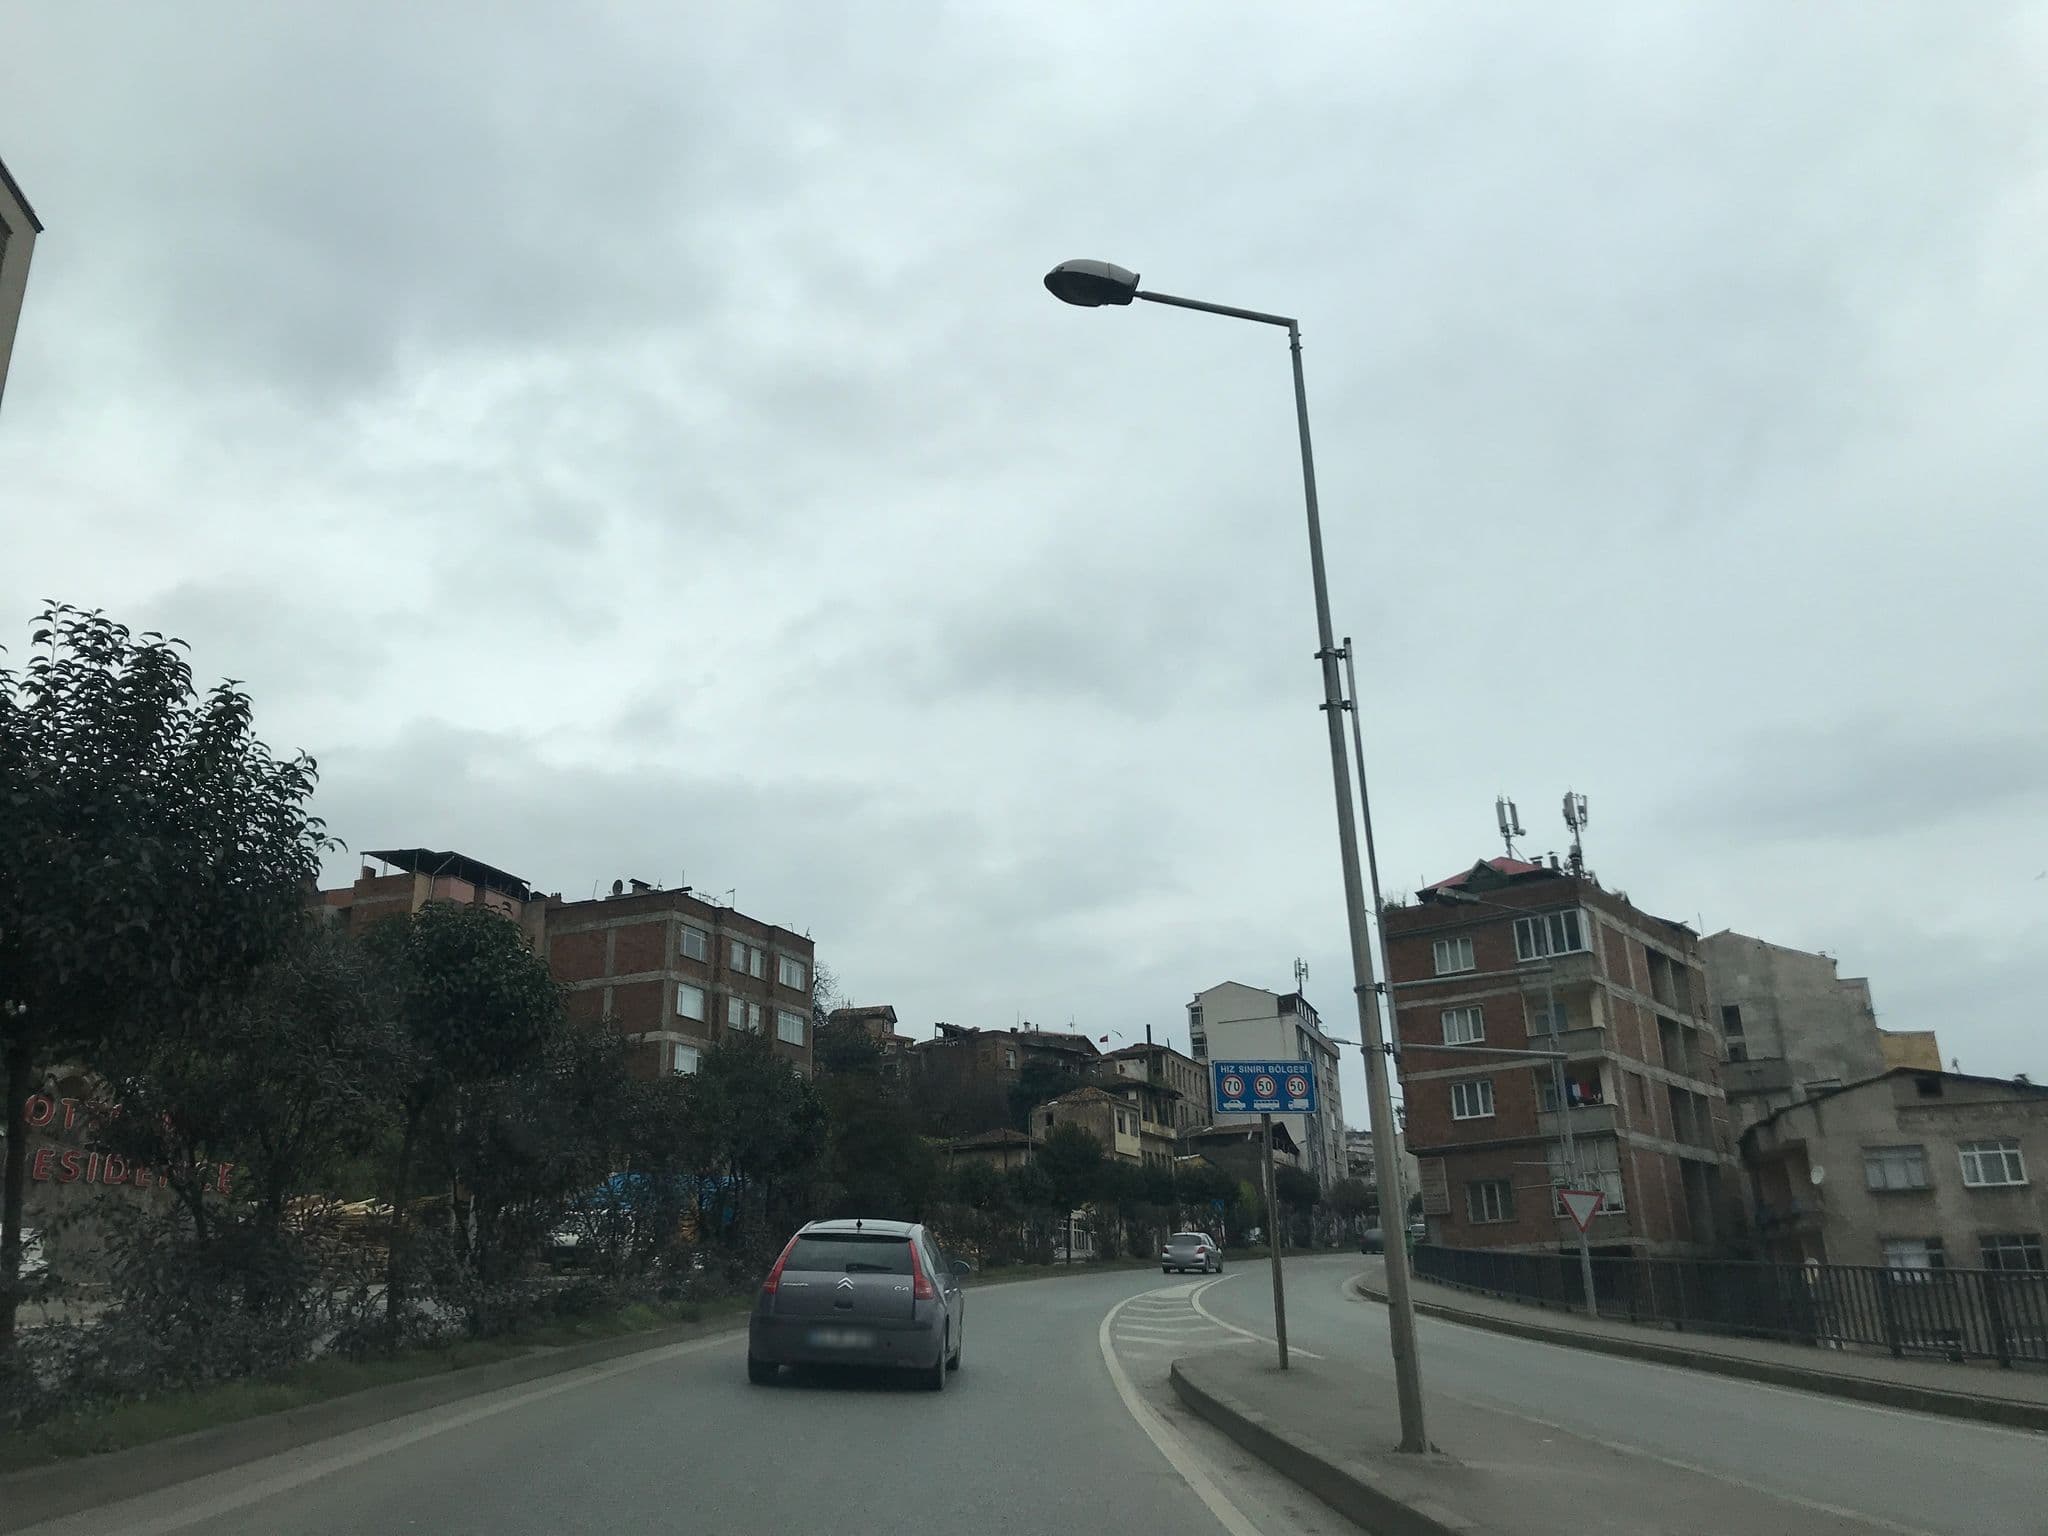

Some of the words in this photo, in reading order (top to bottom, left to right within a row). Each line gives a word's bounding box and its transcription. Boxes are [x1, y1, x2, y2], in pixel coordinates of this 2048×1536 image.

[1226, 1080, 1240, 1091] 70
[1258, 1080, 1272, 1091] 50
[1290, 1080, 1304, 1091] 50
